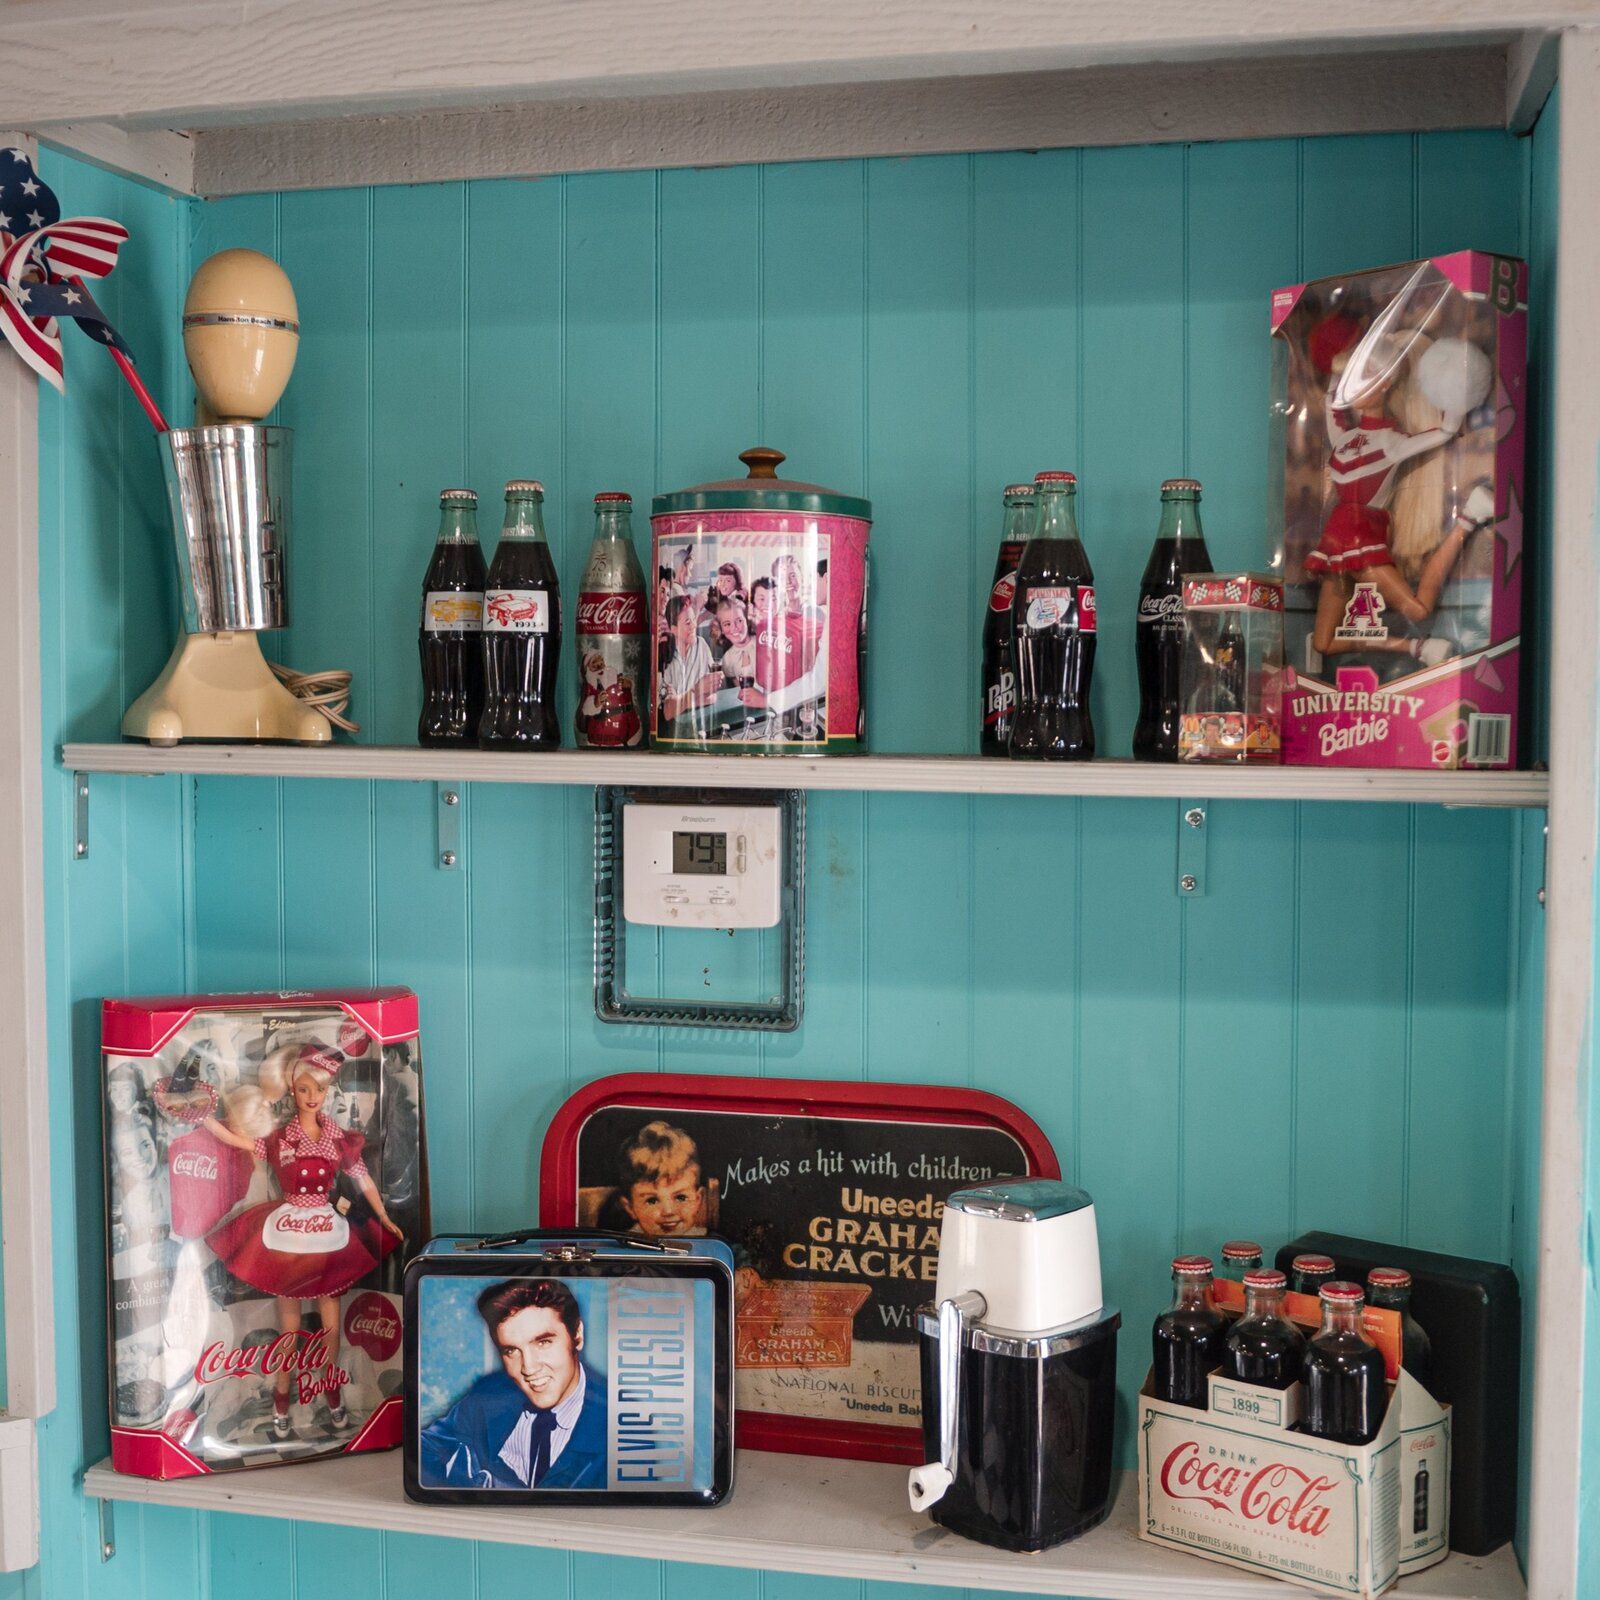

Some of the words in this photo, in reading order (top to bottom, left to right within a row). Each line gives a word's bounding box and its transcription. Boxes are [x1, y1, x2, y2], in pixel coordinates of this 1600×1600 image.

[1292, 691, 1425, 719] UNIVERSITY
[1318, 714, 1389, 756] Barbie
[678, 832, 714, 863] 79
[172, 1152, 218, 1181] Coca-Cola
[721, 1156, 791, 1199] Makes
[798, 1159, 811, 1174] a
[817, 1149, 844, 1176] hit
[851, 1153, 899, 1179] with
[908, 1154, 992, 1181] children
[841, 1187, 946, 1219] Uneeda
[276, 1213, 334, 1234] Coca-Cola
[808, 1216, 941, 1250] GRAHA
[782, 1243, 940, 1281] CRACKE
[127, 1279, 138, 1294] A
[878, 1304, 911, 1328] Wi
[194, 1327, 333, 1386] Coca-Cola
[617, 1286, 685, 1403] PRESLEY
[748, 1351, 838, 1363] CRACKERS
[757, 1338, 825, 1350] GRAHAM
[296, 1363, 350, 1405] Barbie
[776, 1374, 857, 1394] NATIONAL
[1232, 1397, 1260, 1414] 1899
[617, 1412, 685, 1482] ELVIS
[1208, 1445, 1259, 1465] DRINK
[1160, 1441, 1341, 1536] Coca-Cola
[1197, 1533, 1221, 1548] BOTTLES
[1290, 1559, 1317, 1575] BOTTLES
